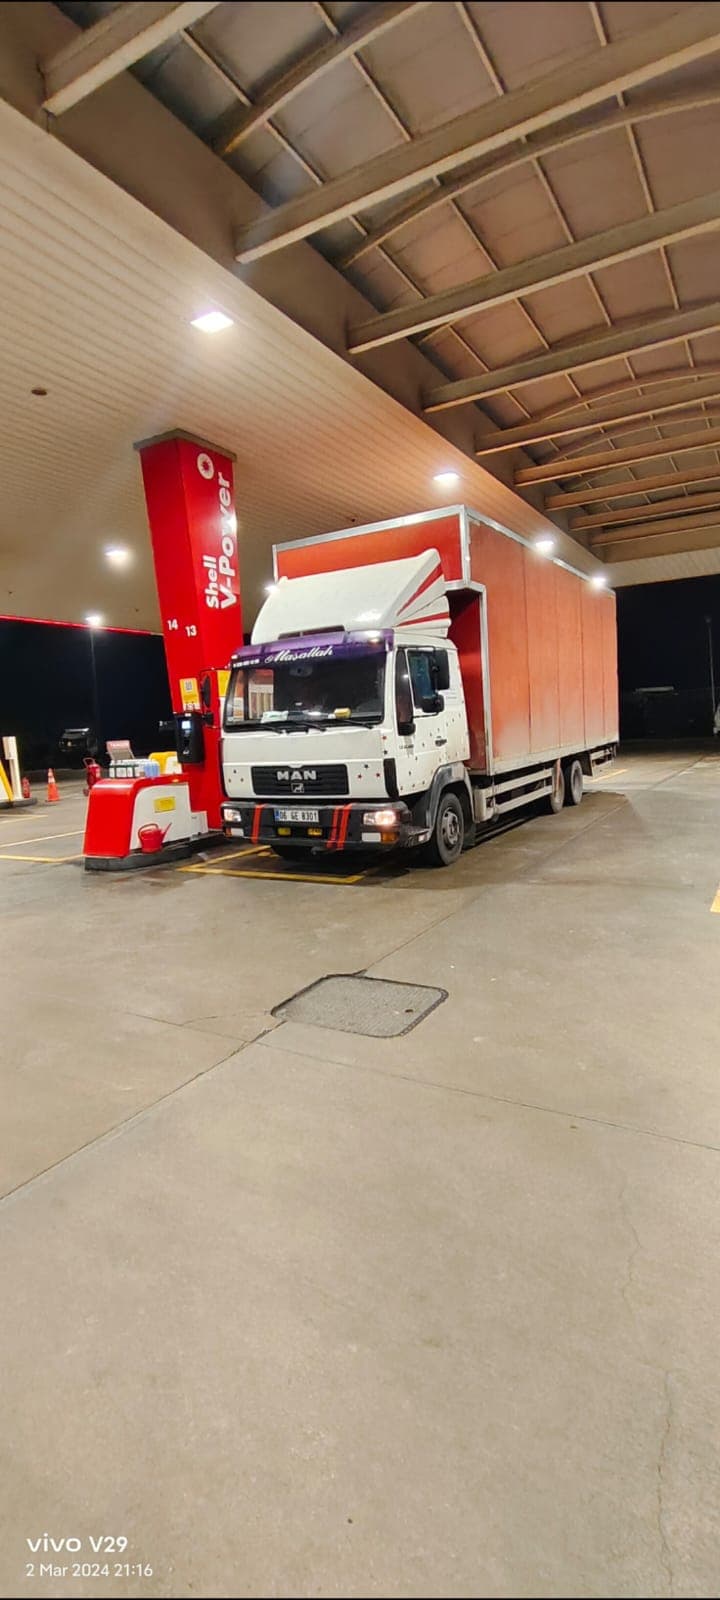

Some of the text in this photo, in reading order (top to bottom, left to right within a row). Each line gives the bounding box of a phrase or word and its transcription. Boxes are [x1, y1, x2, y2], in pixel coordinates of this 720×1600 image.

[218, 472, 237, 609] V-Power
[202, 555, 219, 609] Shell
[167, 619, 179, 631] 14
[185, 625, 197, 637] 13
[276, 770, 317, 781] MAN
